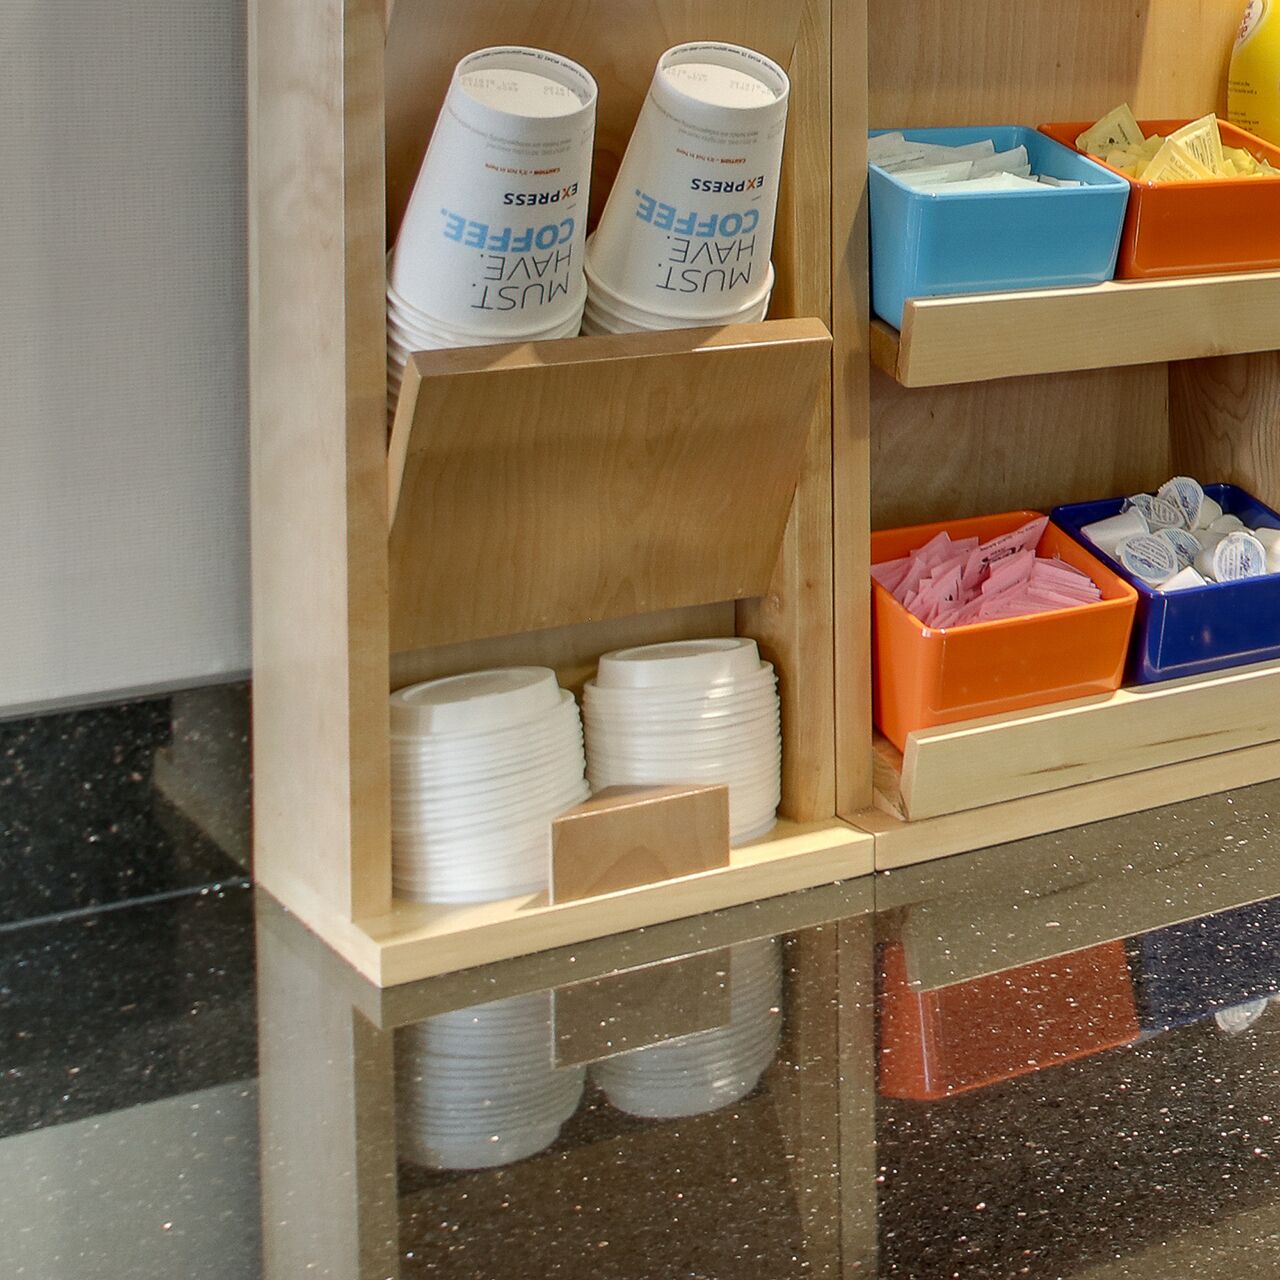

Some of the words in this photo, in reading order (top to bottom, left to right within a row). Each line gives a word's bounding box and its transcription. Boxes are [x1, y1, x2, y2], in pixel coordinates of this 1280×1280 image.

[503, 182, 578, 206] EXPRESS
[690, 175, 764, 193] EXPRESS
[440, 207, 575, 253] COFFEE.
[634, 189, 760, 238] COFFEE.
[480, 244, 572, 280] HAVE.
[667, 234, 755, 265] HAVE.
[471, 271, 569, 311] MUST.
[656, 262, 751, 293] MUST.
